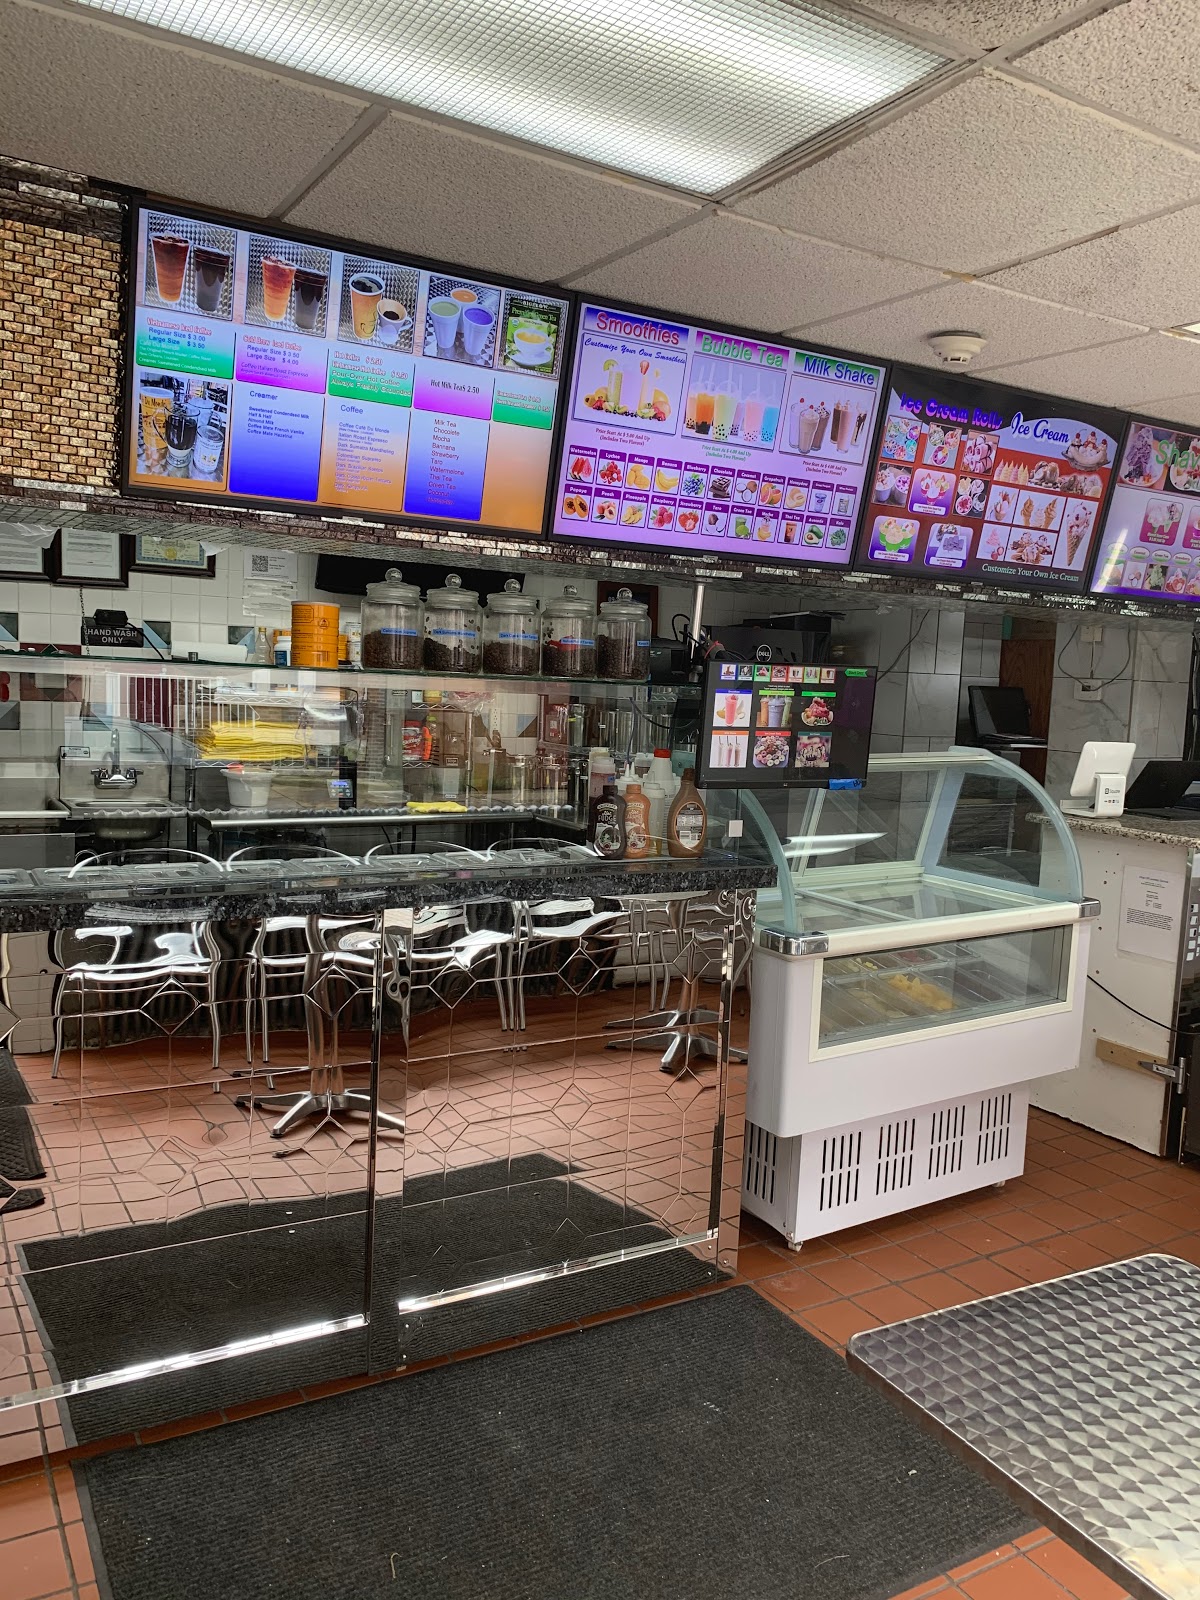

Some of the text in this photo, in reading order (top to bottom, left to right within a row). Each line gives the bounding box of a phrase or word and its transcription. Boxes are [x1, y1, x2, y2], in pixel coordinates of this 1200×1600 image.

[149, 327, 171, 337] Regular
[194, 326, 212, 336] Coffee
[596, 311, 680, 346] Smoothies
[149, 335, 166, 344] Large
[247, 345, 268, 353] Regular
[585, 337, 618, 352] Customize
[620, 345, 636, 356] Your
[638, 348, 653, 358] Own
[701, 334, 784, 368] Bubble Tea
[804, 356, 875, 386] Milk Shake
[332, 370, 365, 381] Pour-Over
[380, 378, 400, 387] Coffee
[250, 391, 278, 400] Creamer
[467, 386, 480, 394] 2.50
[341, 404, 364, 414] Coffee
[900, 393, 1003, 430] Ice Cream Rolls
[1011, 411, 1070, 444] Ice Cream
[431, 450, 460, 460] Strawberry
[982, 563, 1079, 582] Customize Your Own Ice Cream
